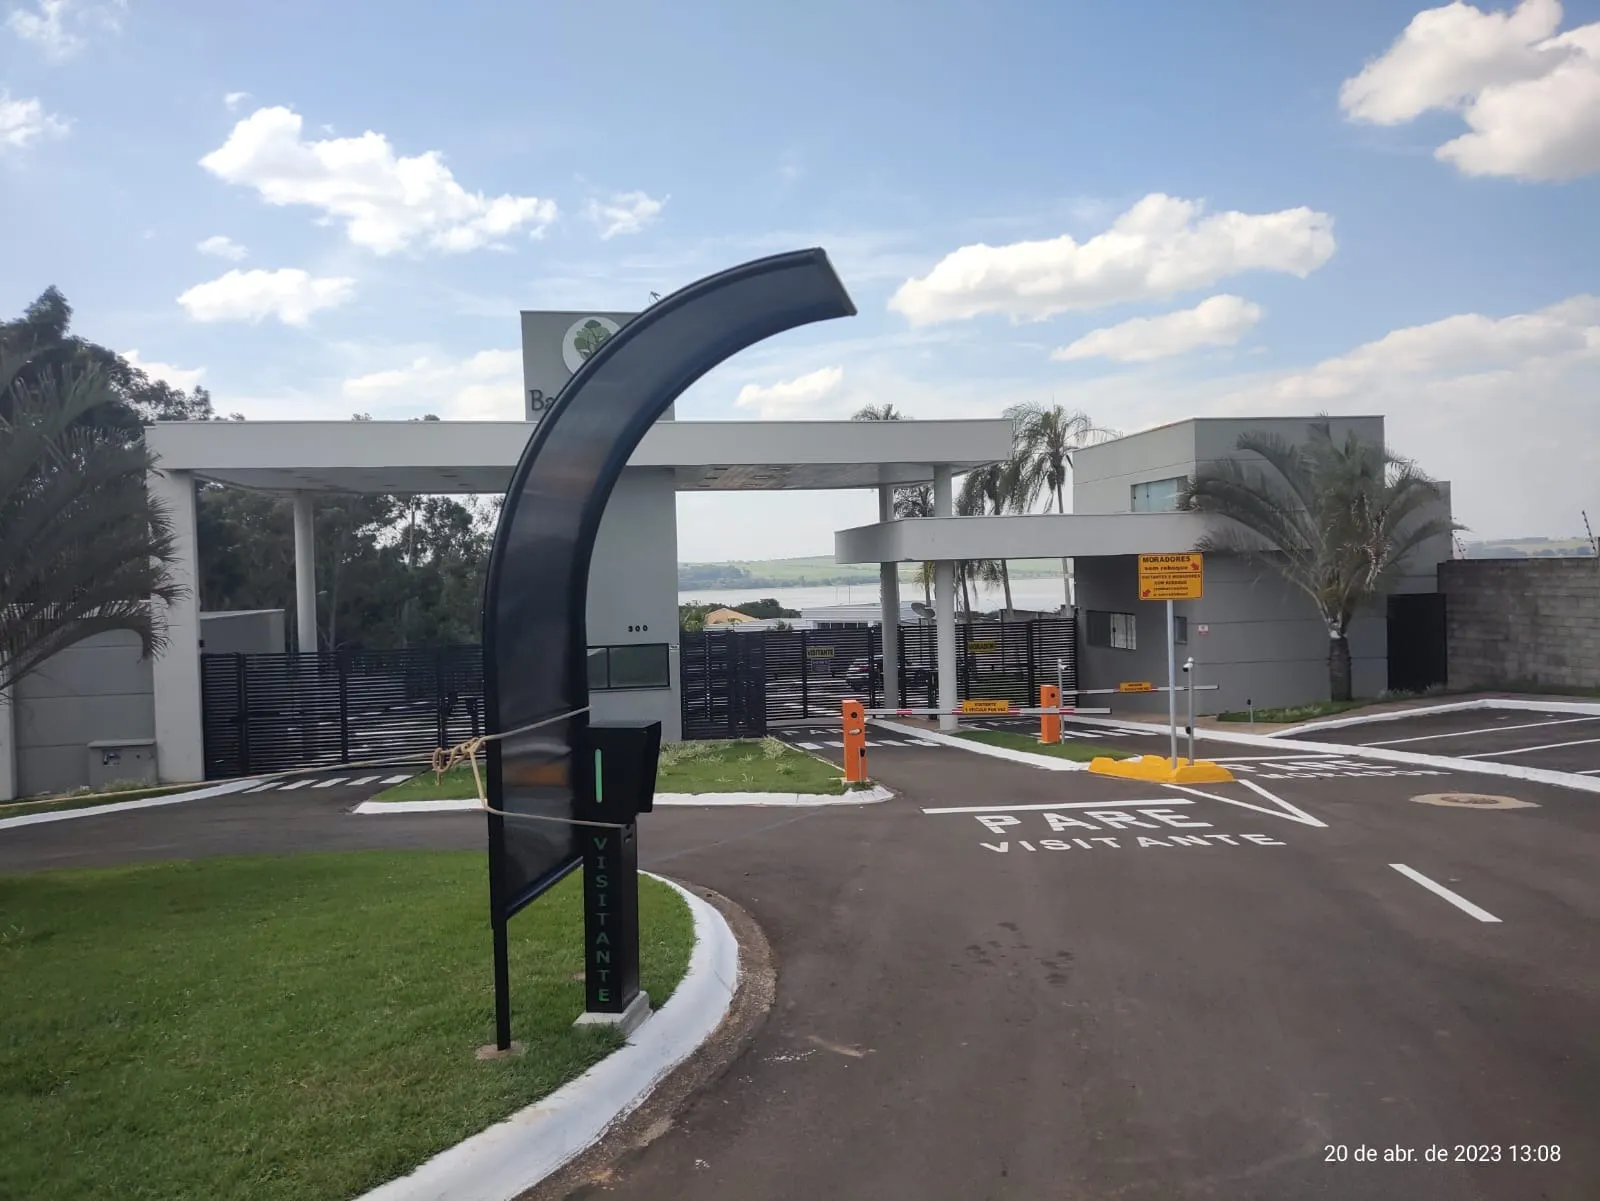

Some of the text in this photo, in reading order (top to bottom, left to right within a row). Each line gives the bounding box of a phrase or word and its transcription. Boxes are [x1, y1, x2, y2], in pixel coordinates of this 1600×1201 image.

[628, 624, 648, 632] 300
[975, 808, 1214, 834] PARE
[980, 833, 1287, 853] VISITANTE
[593, 837, 611, 1002] VISITANTE
